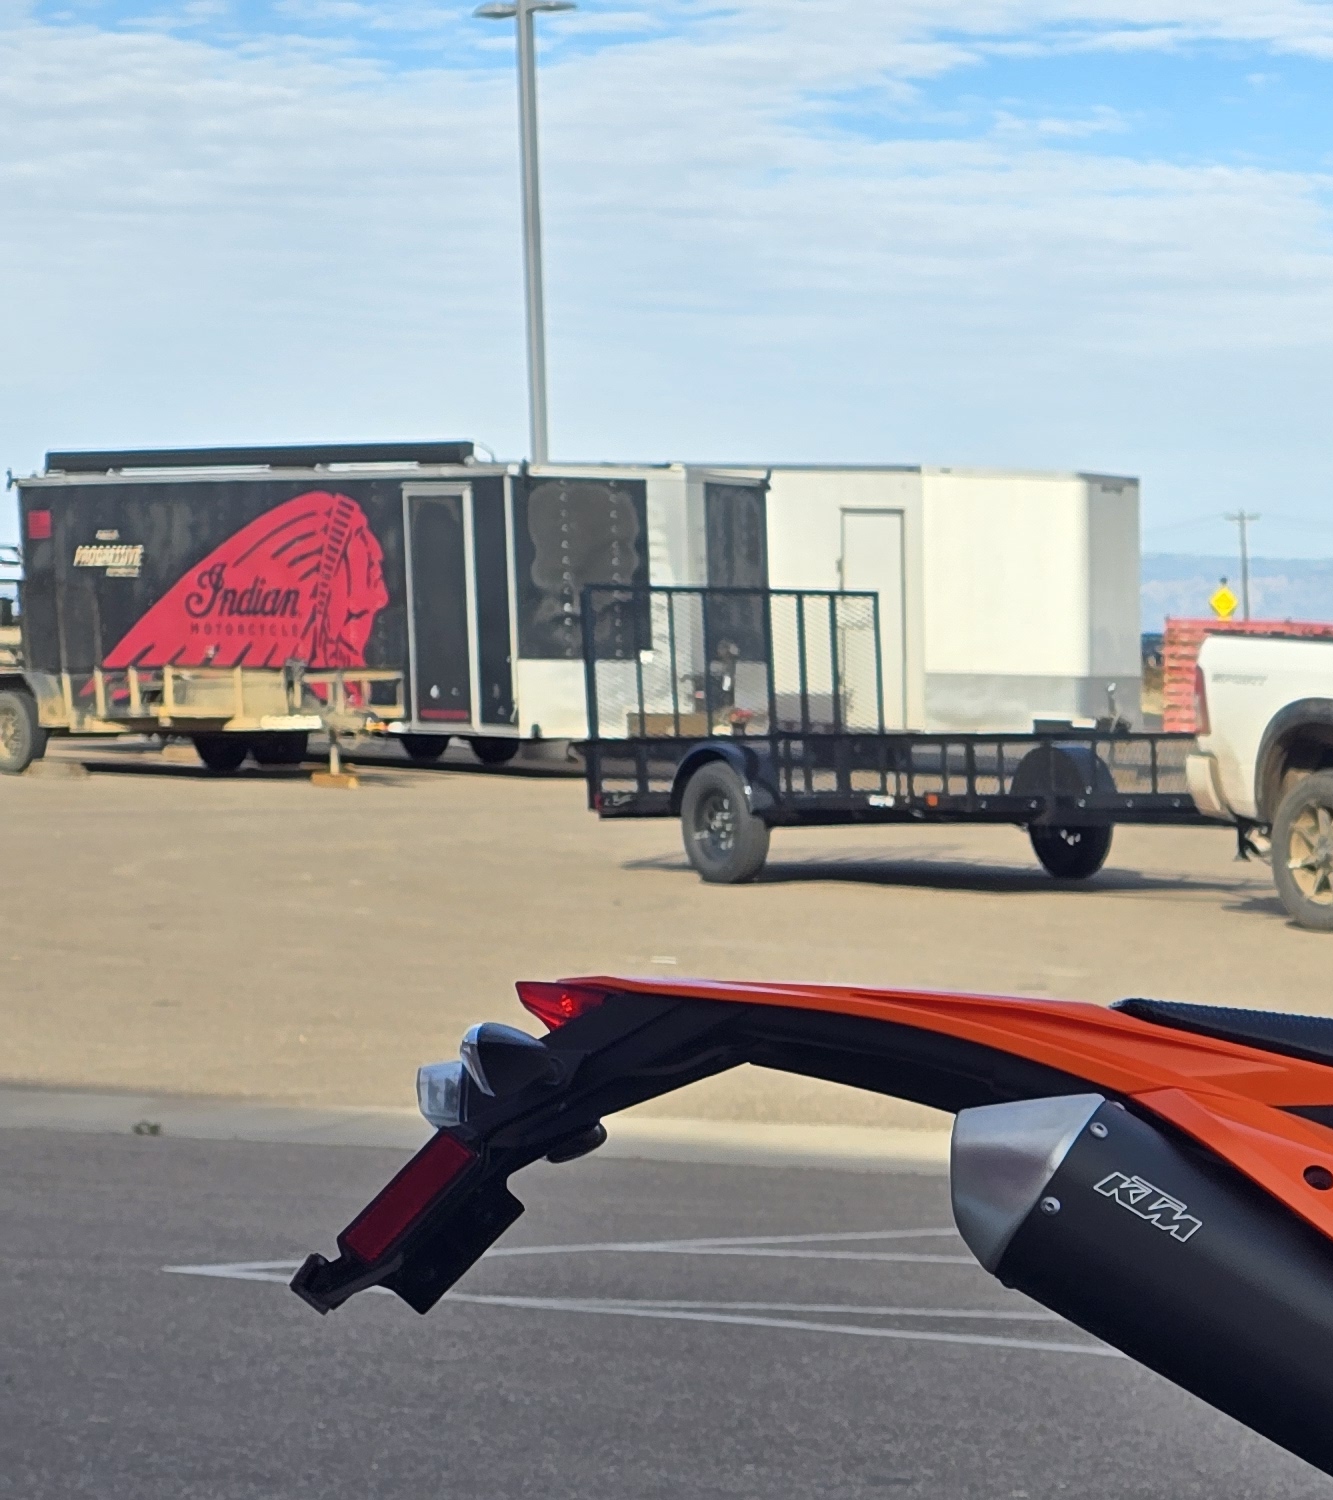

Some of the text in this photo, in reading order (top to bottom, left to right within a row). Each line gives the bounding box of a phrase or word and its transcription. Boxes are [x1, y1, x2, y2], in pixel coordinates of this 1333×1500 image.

[185, 563, 300, 618] Indian
[190, 622, 299, 637] MOTORCYCLE
[1093, 1171, 1203, 1243] KTM
